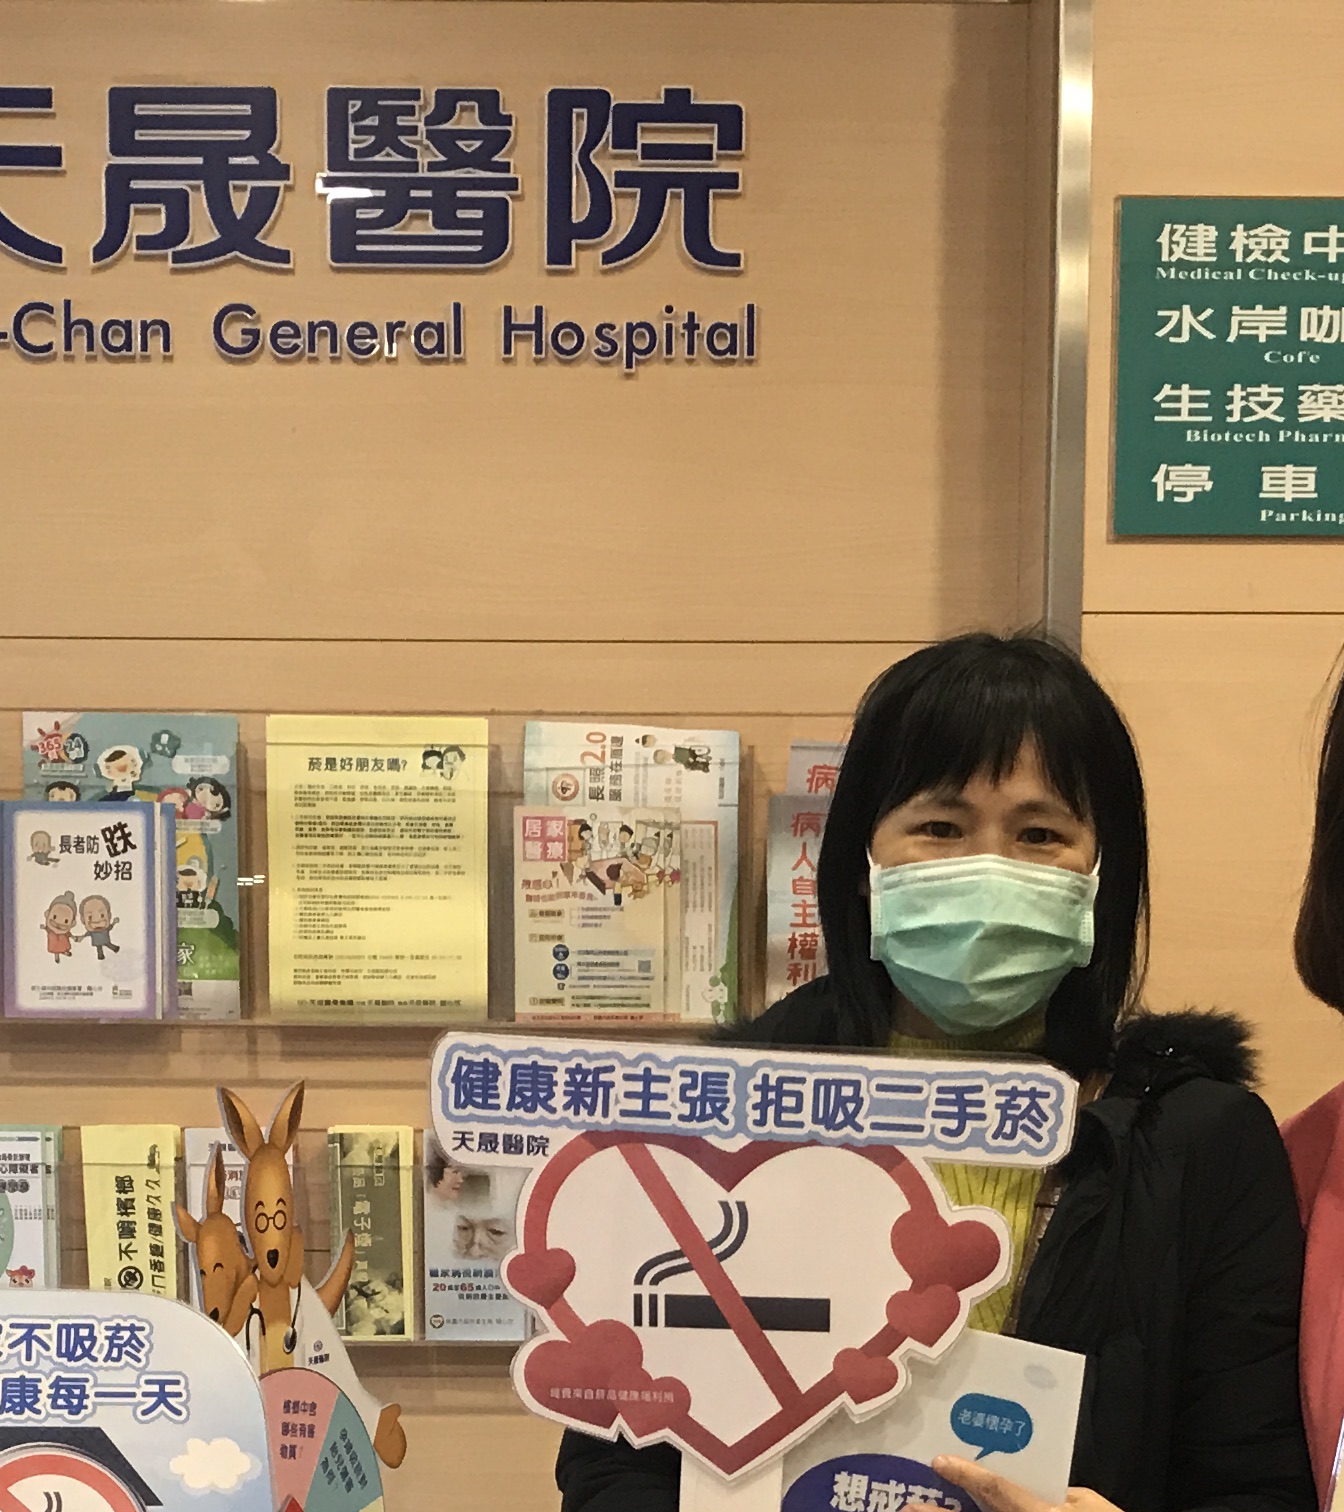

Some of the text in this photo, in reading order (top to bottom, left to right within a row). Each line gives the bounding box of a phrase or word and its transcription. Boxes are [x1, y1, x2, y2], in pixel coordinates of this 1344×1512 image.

[1156, 267, 1242, 280] Medical
[212, 299, 465, 359] General
[502, 302, 759, 371] Hospital
[1186, 429, 1271, 443] Biotech
[806, 764, 838, 794] 病
[59, 822, 137, 857] 長者防跌
[94, 860, 132, 881] 妙招
[787, 811, 826, 986] 病人自主權利
[451, 1058, 1050, 1142] 健康新主張 拒吸二手菸
[452, 1130, 549, 1157] 天晟醫院
[958, 1408, 1026, 1437] 老婆懷孕了
